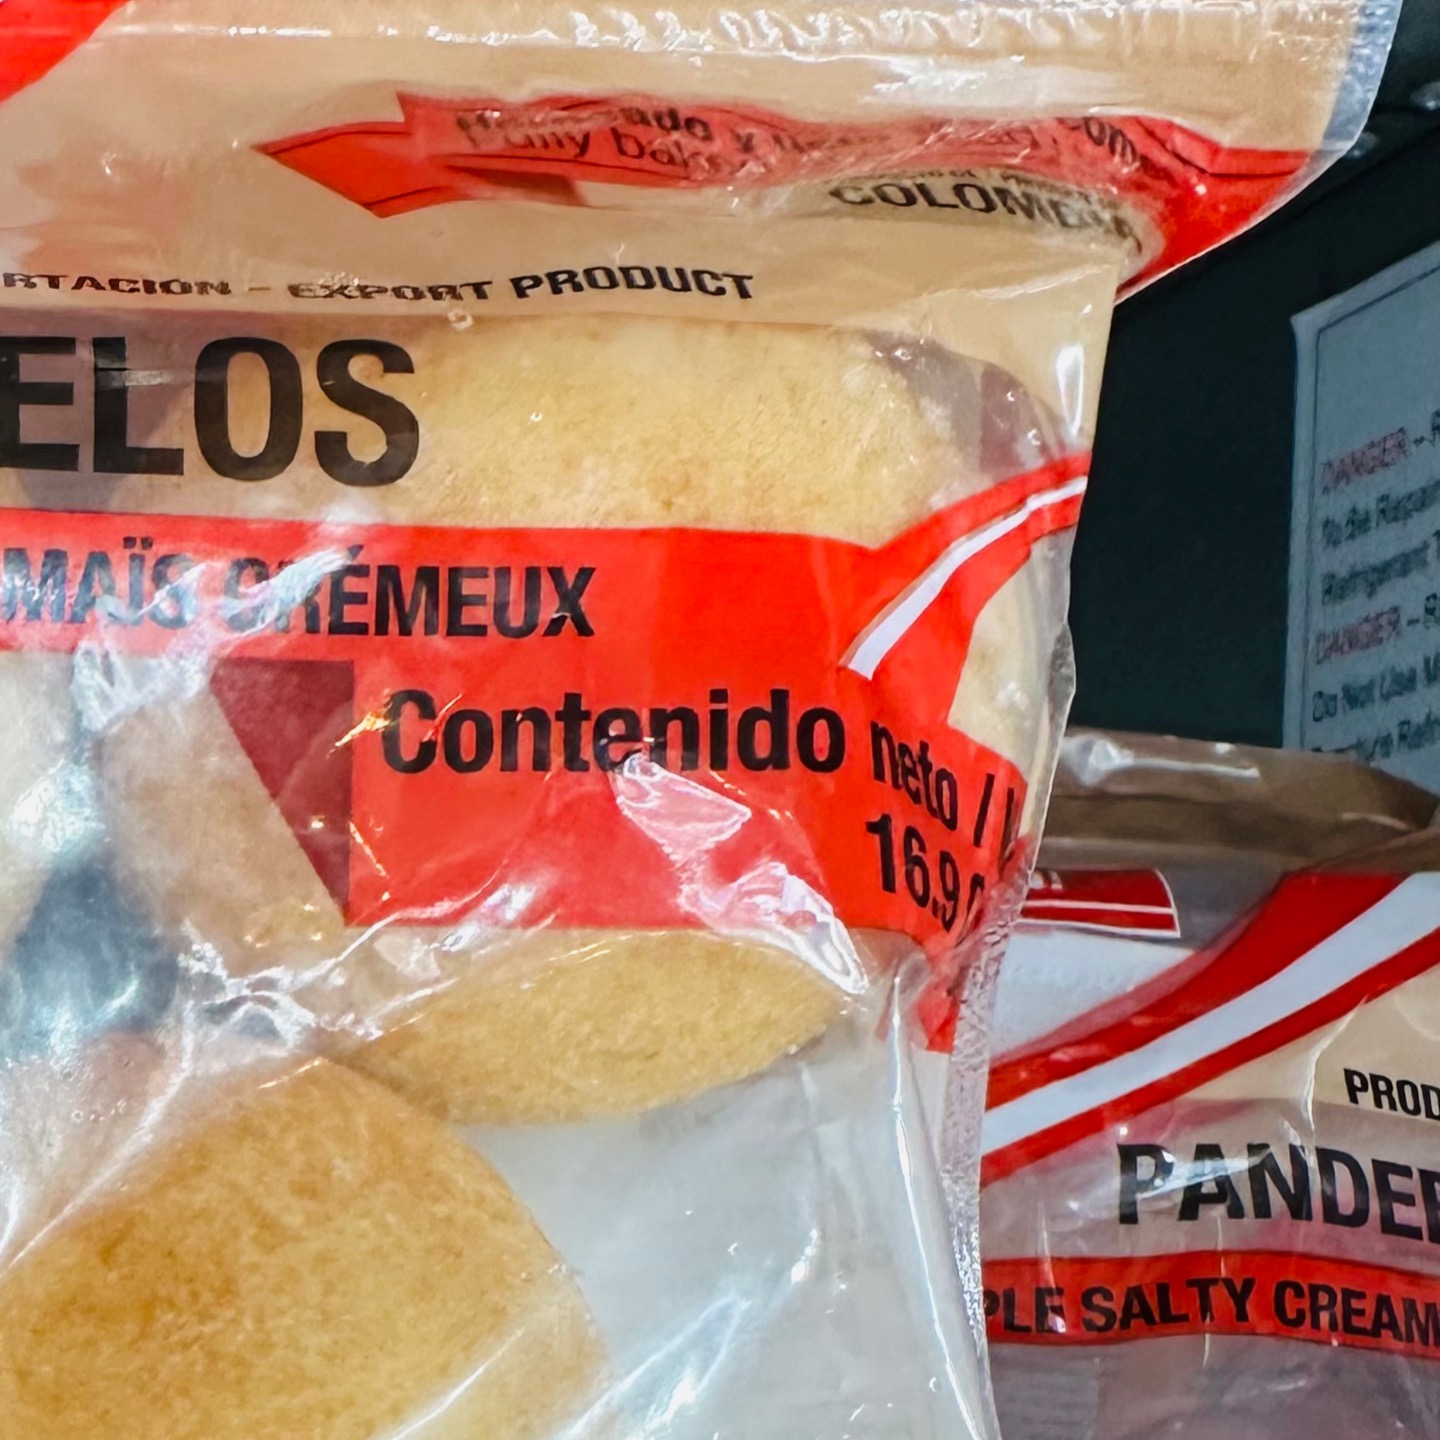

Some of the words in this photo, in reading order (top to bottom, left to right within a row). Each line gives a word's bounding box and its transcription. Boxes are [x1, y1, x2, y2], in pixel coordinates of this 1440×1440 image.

[288, 280, 492, 302] EXPORT
[511, 266, 754, 299] PRODUCT
[2, 536, 197, 629] MAÏS
[382, 688, 846, 774] Contenido
[870, 720, 957, 831] neto
[866, 813, 960, 932] 16.9
[1081, 1277, 1256, 1333] SALTY
[1274, 1280, 1440, 1348] CREAM
